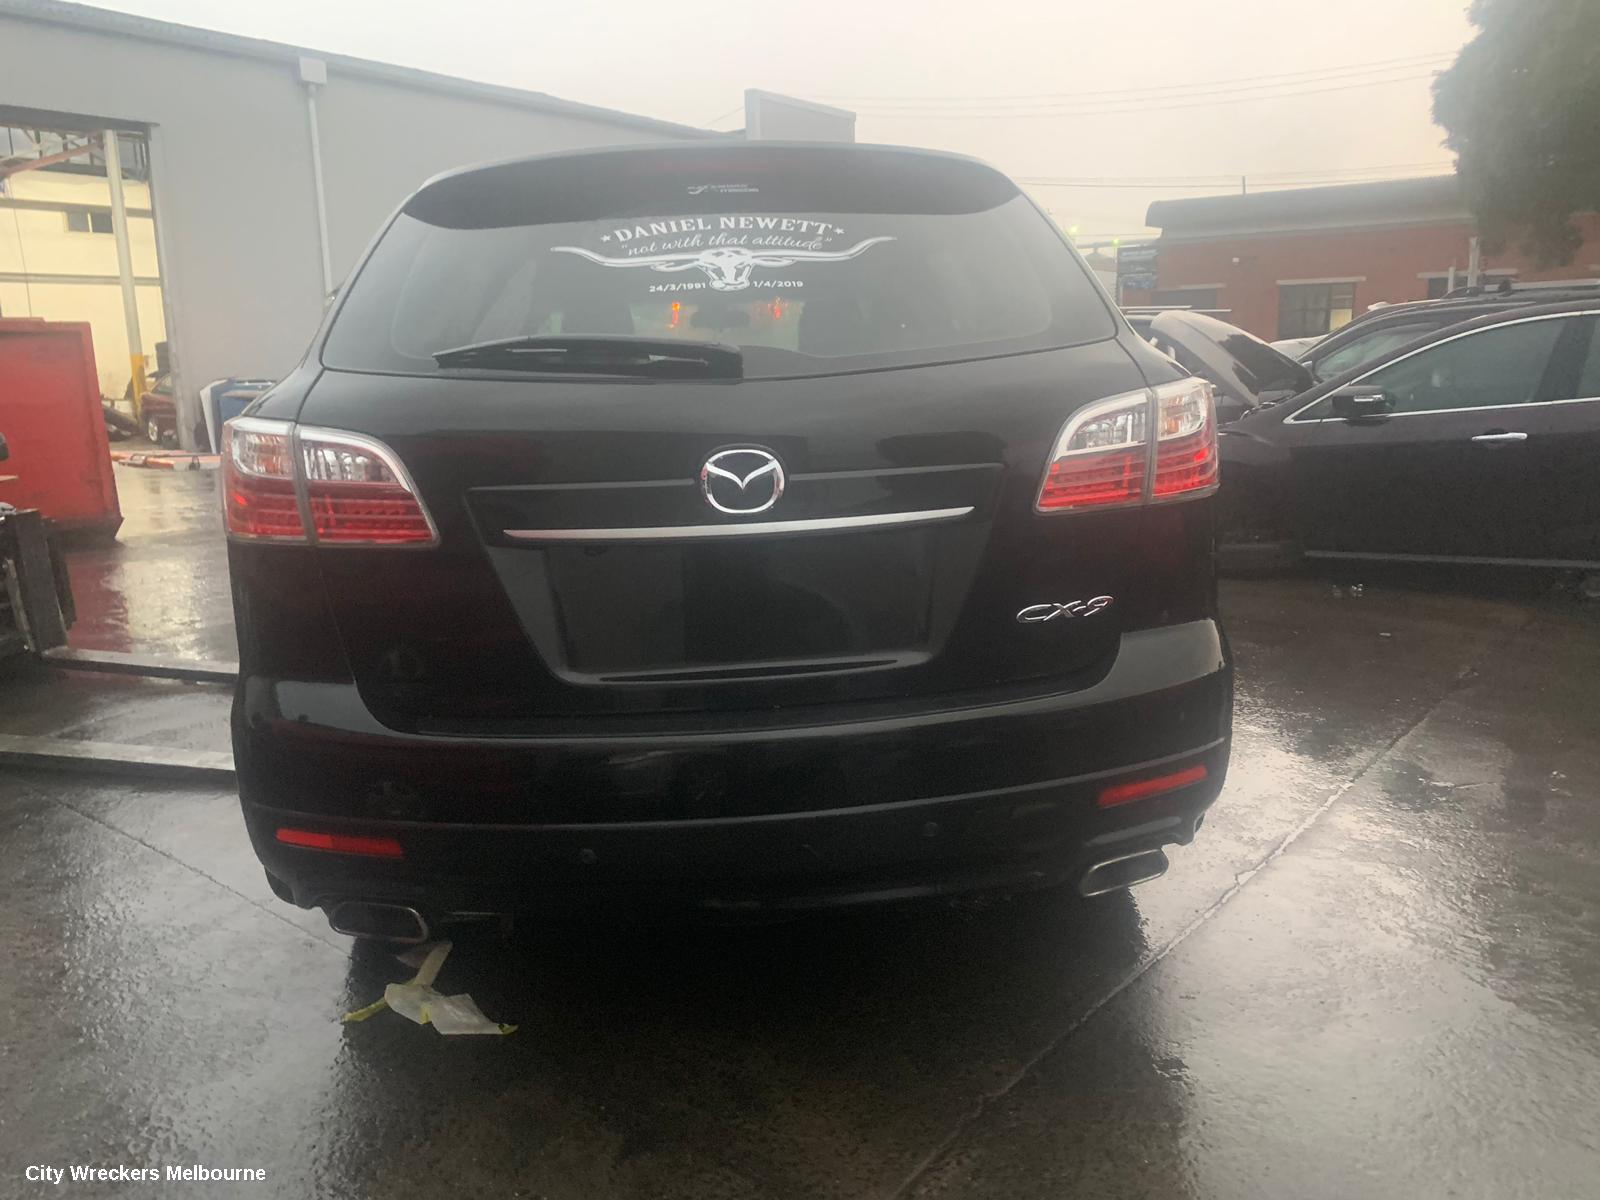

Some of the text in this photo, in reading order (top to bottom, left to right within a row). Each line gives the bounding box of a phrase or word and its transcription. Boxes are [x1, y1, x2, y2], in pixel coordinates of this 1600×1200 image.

[613, 215, 833, 242] DANIEL NEWETT
[662, 235, 705, 250] with
[709, 232, 749, 246] that
[752, 280, 804, 288] 1/4/2019
[1016, 595, 1114, 623] CX-9
